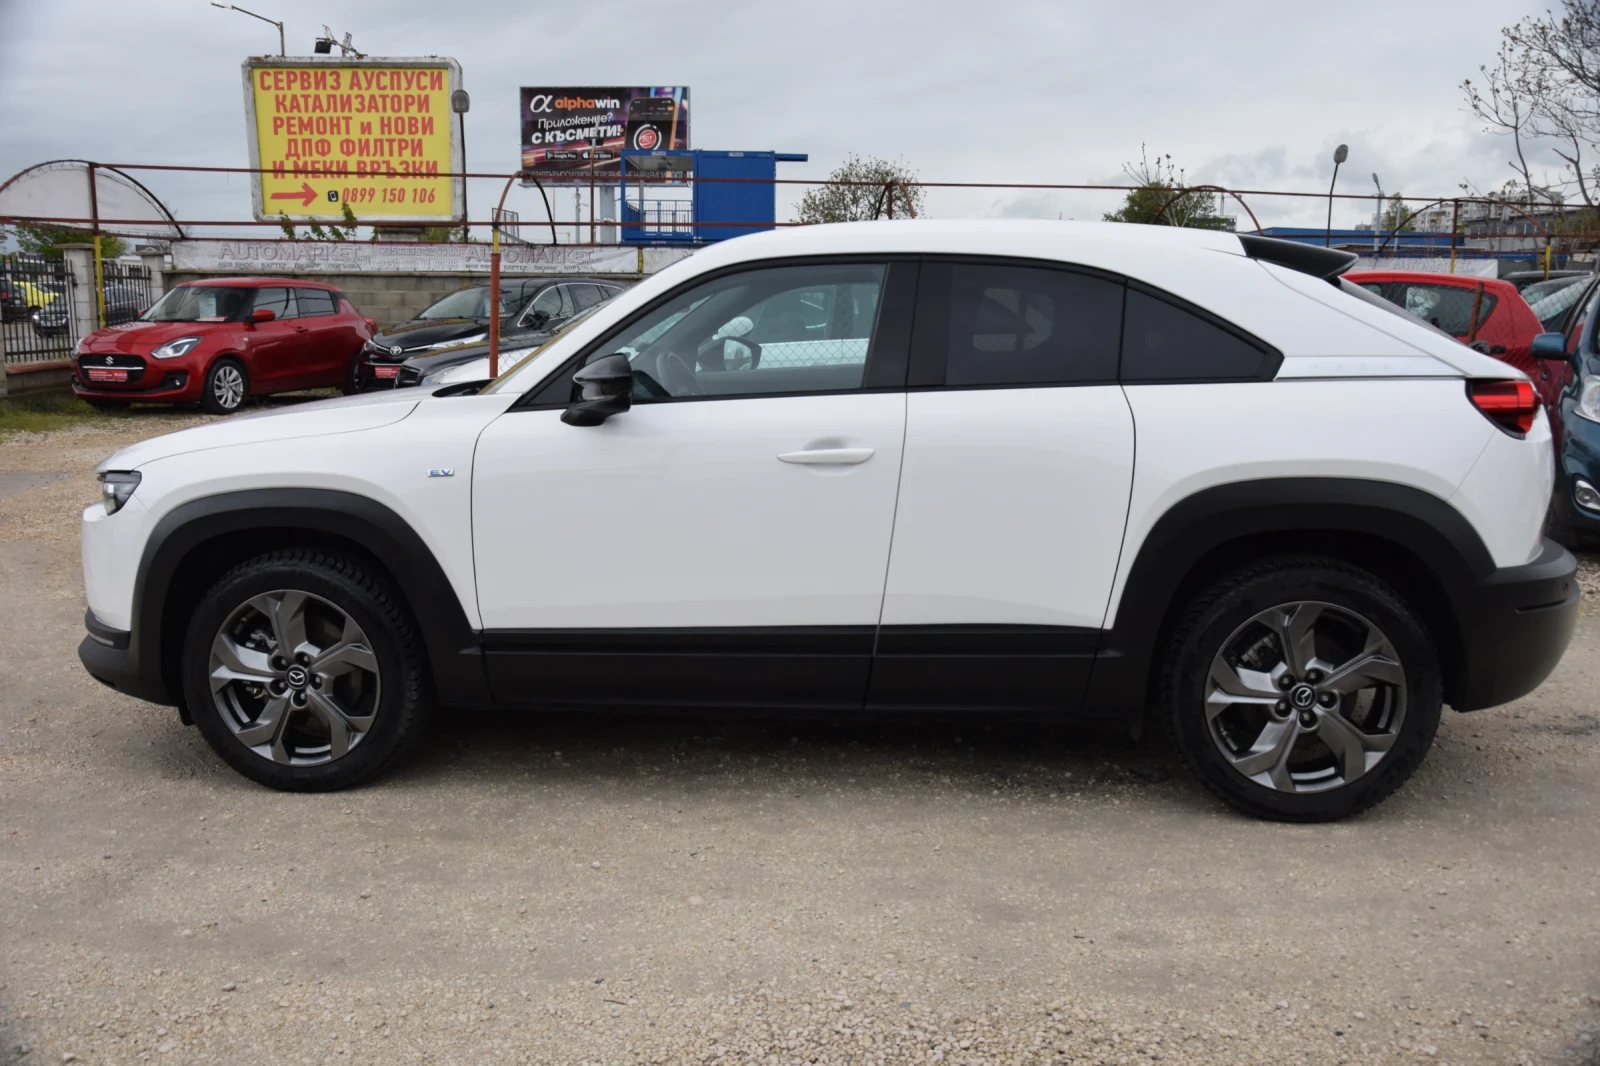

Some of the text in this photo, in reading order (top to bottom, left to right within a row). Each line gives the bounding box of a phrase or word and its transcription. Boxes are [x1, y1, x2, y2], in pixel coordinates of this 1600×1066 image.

[260, 70, 443, 91] СЕРВИЗ АУСПУСИ
[275, 94, 430, 113] КАТАЛИЗАТОРИ
[554, 96, 620, 112] alphawin
[273, 116, 434, 135] РЕМОНТ и НОВИ
[538, 112, 613, 130] Приложение?
[544, 125, 622, 143] КЪСМЕТИ!
[285, 138, 423, 160] ДПФ ФИЛТРИ
[272, 160, 438, 180] И МЕКИ ВРЪЗКИ
[342, 188, 436, 203] 0899 150 106
[218, 242, 361, 261] AUTOMARKET
[428, 469, 453, 477] EV
